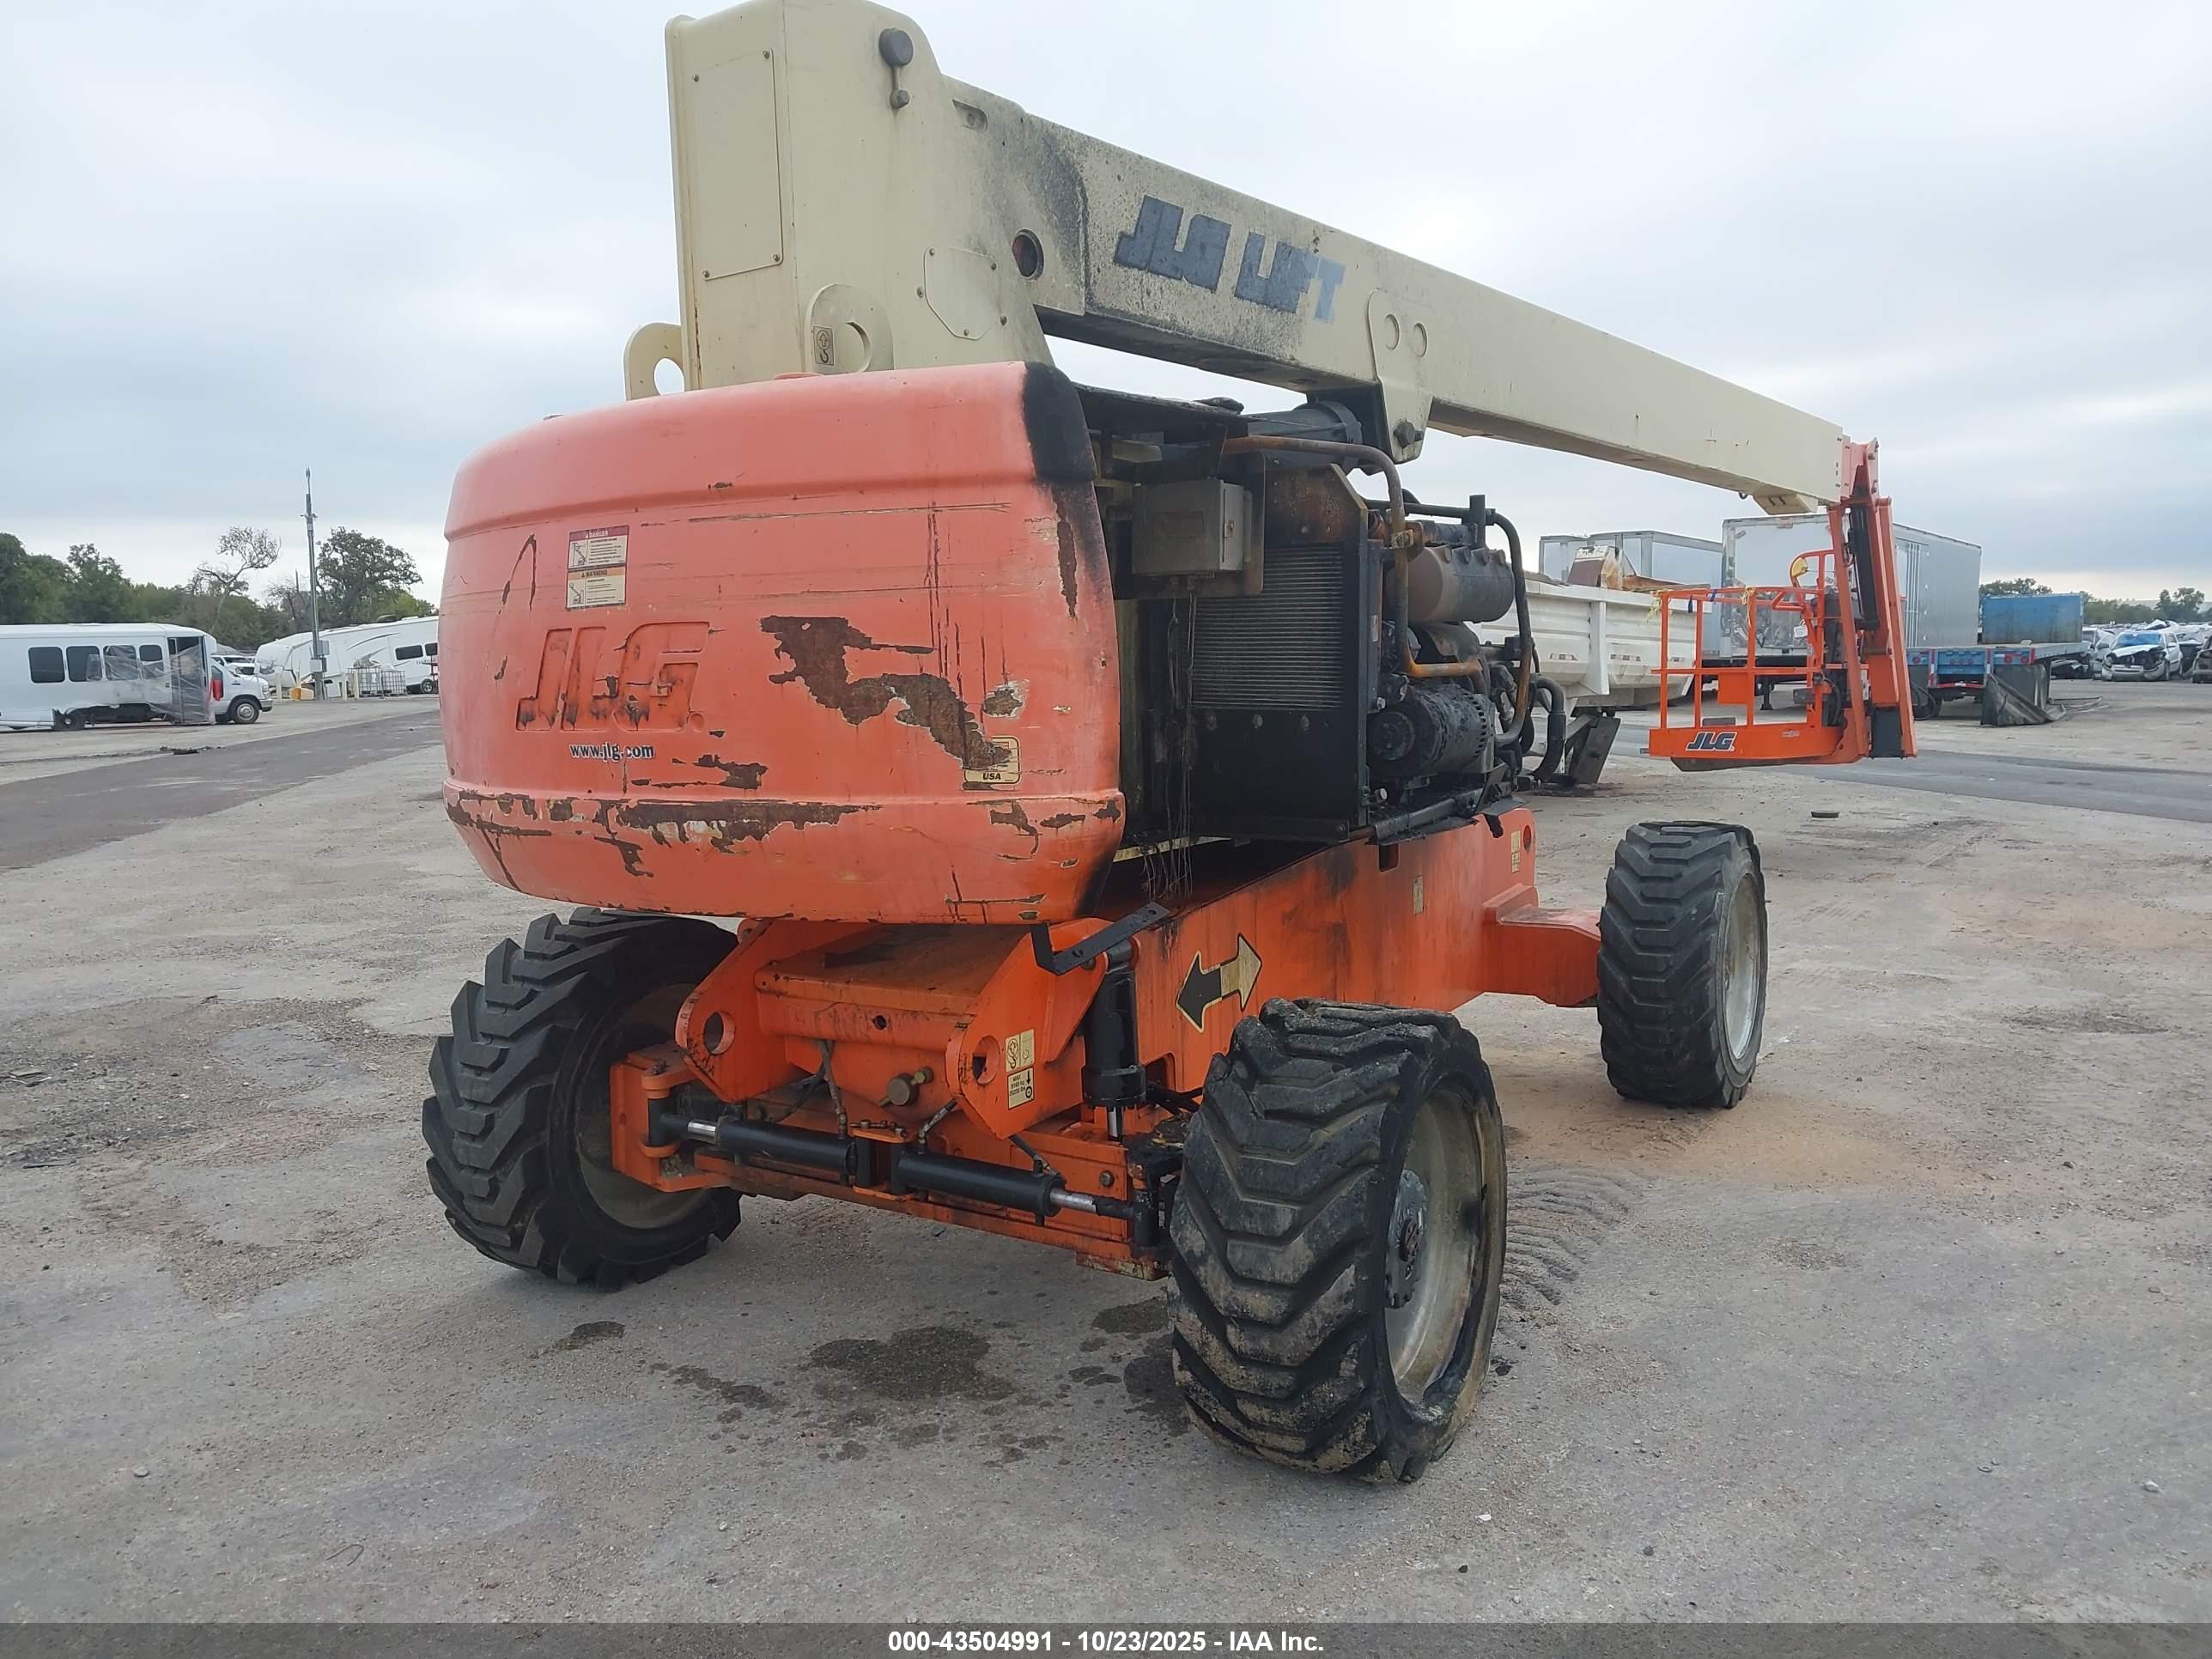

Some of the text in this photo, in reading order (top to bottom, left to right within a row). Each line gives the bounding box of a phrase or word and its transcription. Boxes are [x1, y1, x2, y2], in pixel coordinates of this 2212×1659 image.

[516, 622, 709, 732] JLG
[1686, 732, 1737, 751] JLG
[570, 742, 654, 762] www.jlg.com
